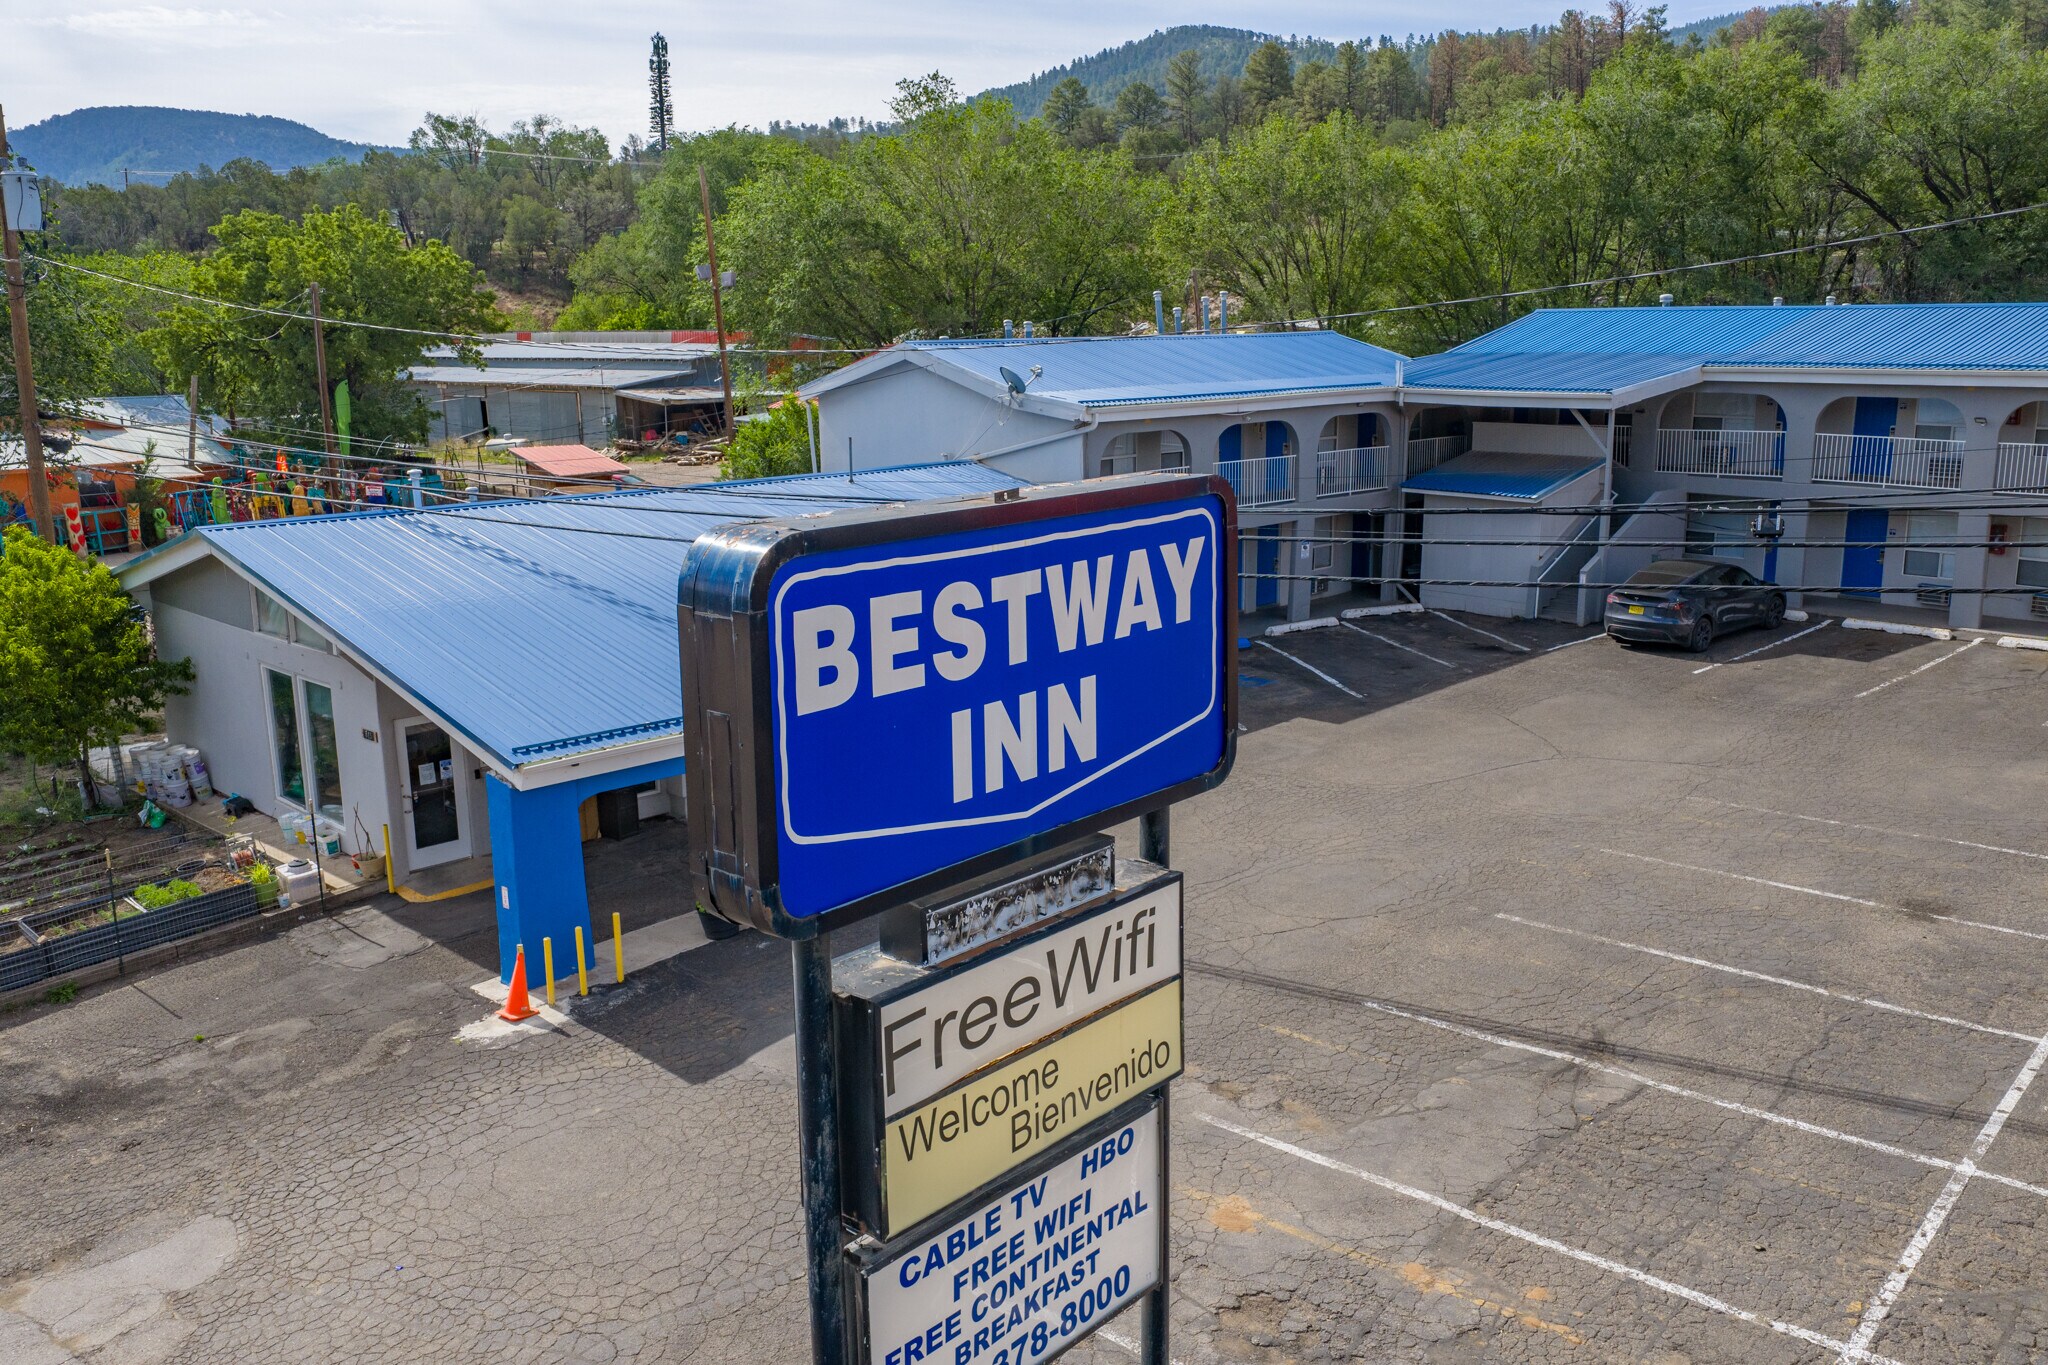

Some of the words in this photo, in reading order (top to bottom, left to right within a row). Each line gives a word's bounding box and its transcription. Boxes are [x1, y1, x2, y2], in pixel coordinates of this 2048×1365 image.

[793, 536, 1205, 716] BESTWAY
[951, 675, 1097, 804] INN
[898, 1058, 1059, 1162] Welcome
[1011, 1039, 1170, 1153] Bienvenido
[899, 1205, 1001, 1288] CABLE
[1010, 1176, 1048, 1220] TV
[1081, 1127, 1135, 1181] HBO
[953, 1230, 1025, 1303] FREE
[1034, 1188, 1092, 1246] WIFI
[885, 1309, 962, 1365] FREE
[971, 1190, 1148, 1322] CONTINENTAL
[955, 1248, 1100, 1365] BREAKFAST
